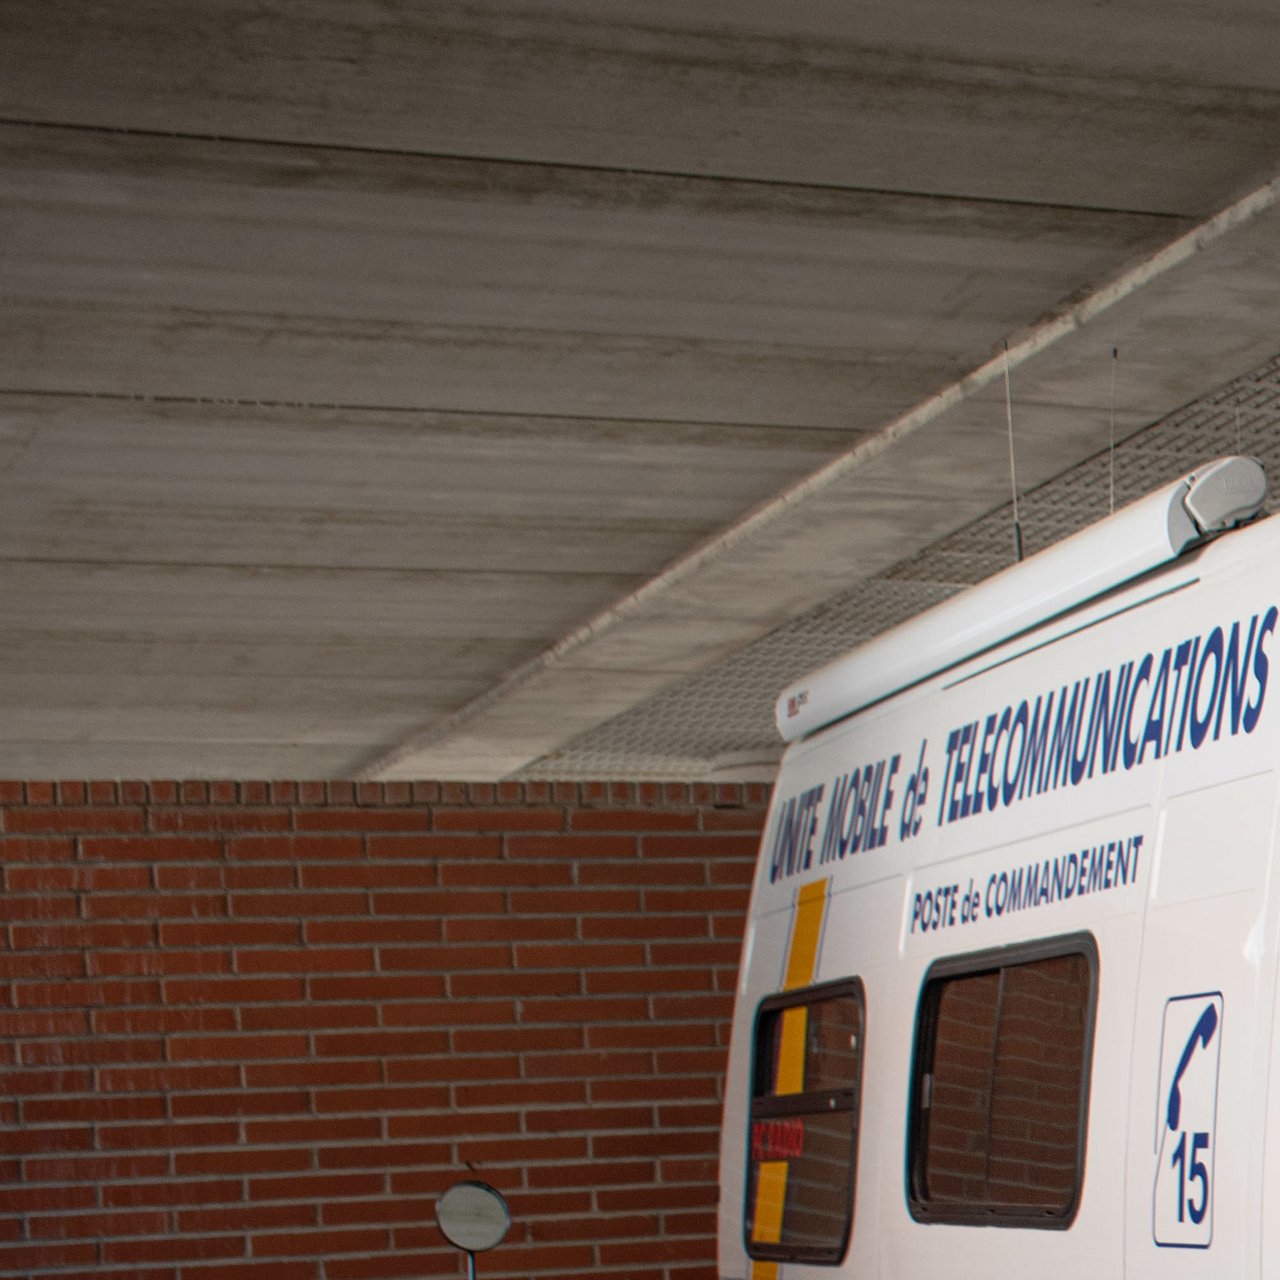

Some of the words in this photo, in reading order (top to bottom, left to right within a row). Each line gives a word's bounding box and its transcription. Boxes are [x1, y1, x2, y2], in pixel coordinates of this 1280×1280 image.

[819, 754, 902, 866] MOBILE
[898, 738, 930, 842] de
[936, 605, 1279, 827] TELECOMMUNICATIONS
[911, 884, 958, 934] POSTE
[960, 877, 981, 925] de
[985, 835, 1144, 918] COMMANDEMENT
[1170, 1131, 1210, 1225] 15
